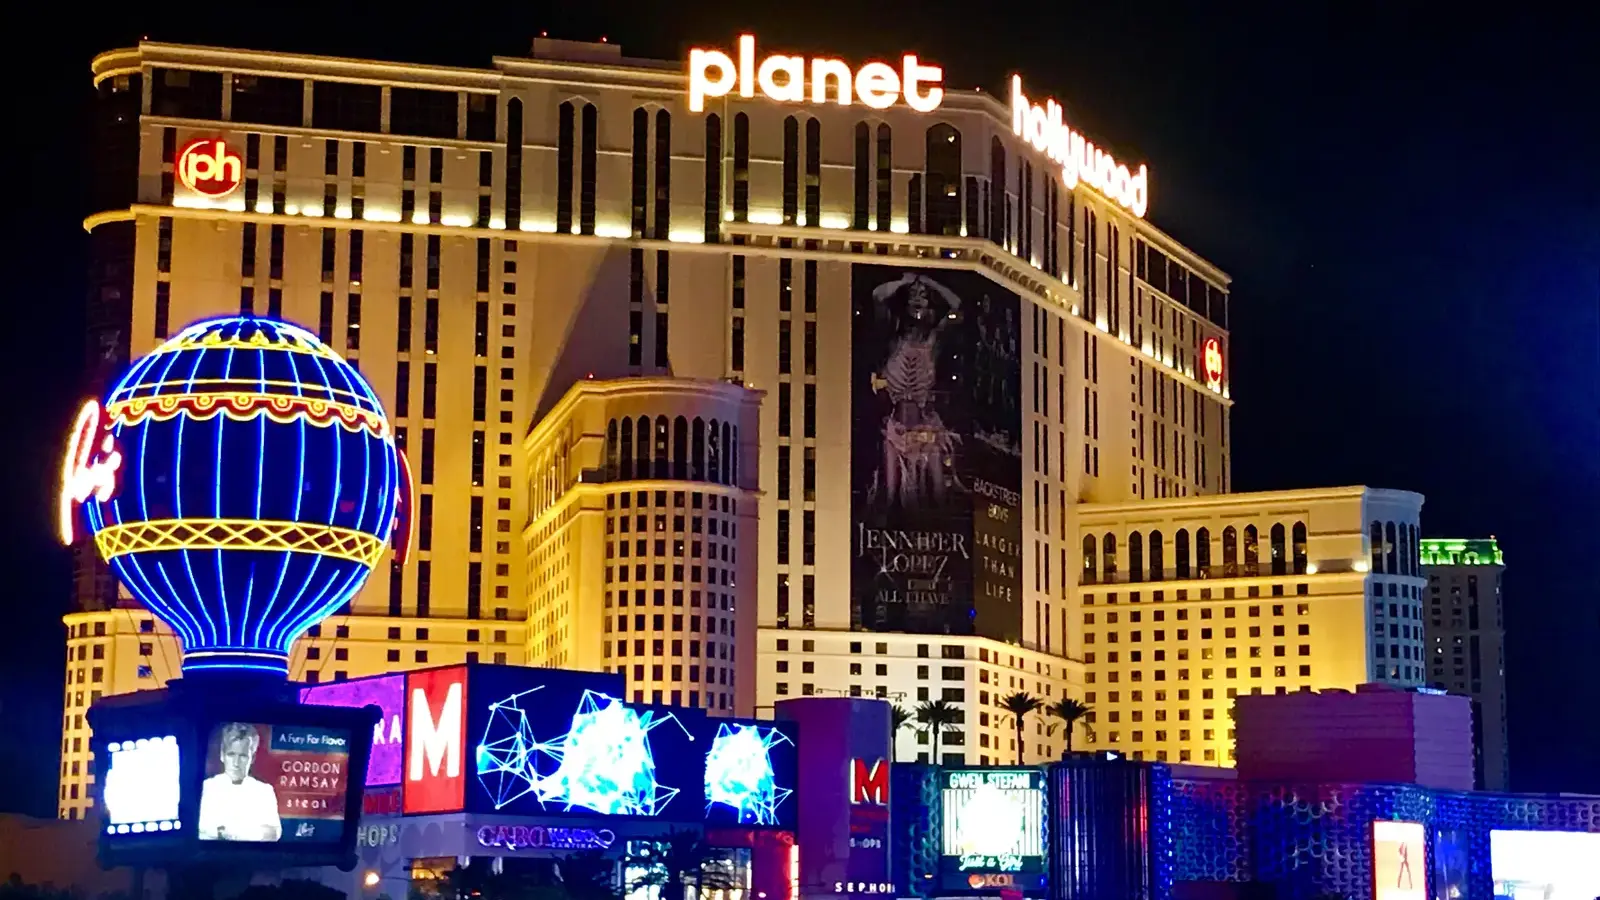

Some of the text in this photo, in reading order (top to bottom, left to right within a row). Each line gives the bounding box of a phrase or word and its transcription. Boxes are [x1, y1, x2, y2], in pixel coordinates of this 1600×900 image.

[689, 34, 944, 112] planet
[1012, 73, 1148, 218] hollywood
[188, 141, 241, 188] ph
[984, 556, 1014, 578] THAN
[985, 581, 1011, 602] LIFE
[280, 733, 287, 742] A
[410, 682, 462, 781] M
[282, 760, 340, 774] GORDON
[280, 775, 339, 789] RAMSAY
[850, 757, 889, 805] M
[949, 773, 1030, 789] GWEN STEFANI
[286, 798, 328, 809] steak
[477, 826, 543, 850] CABO
